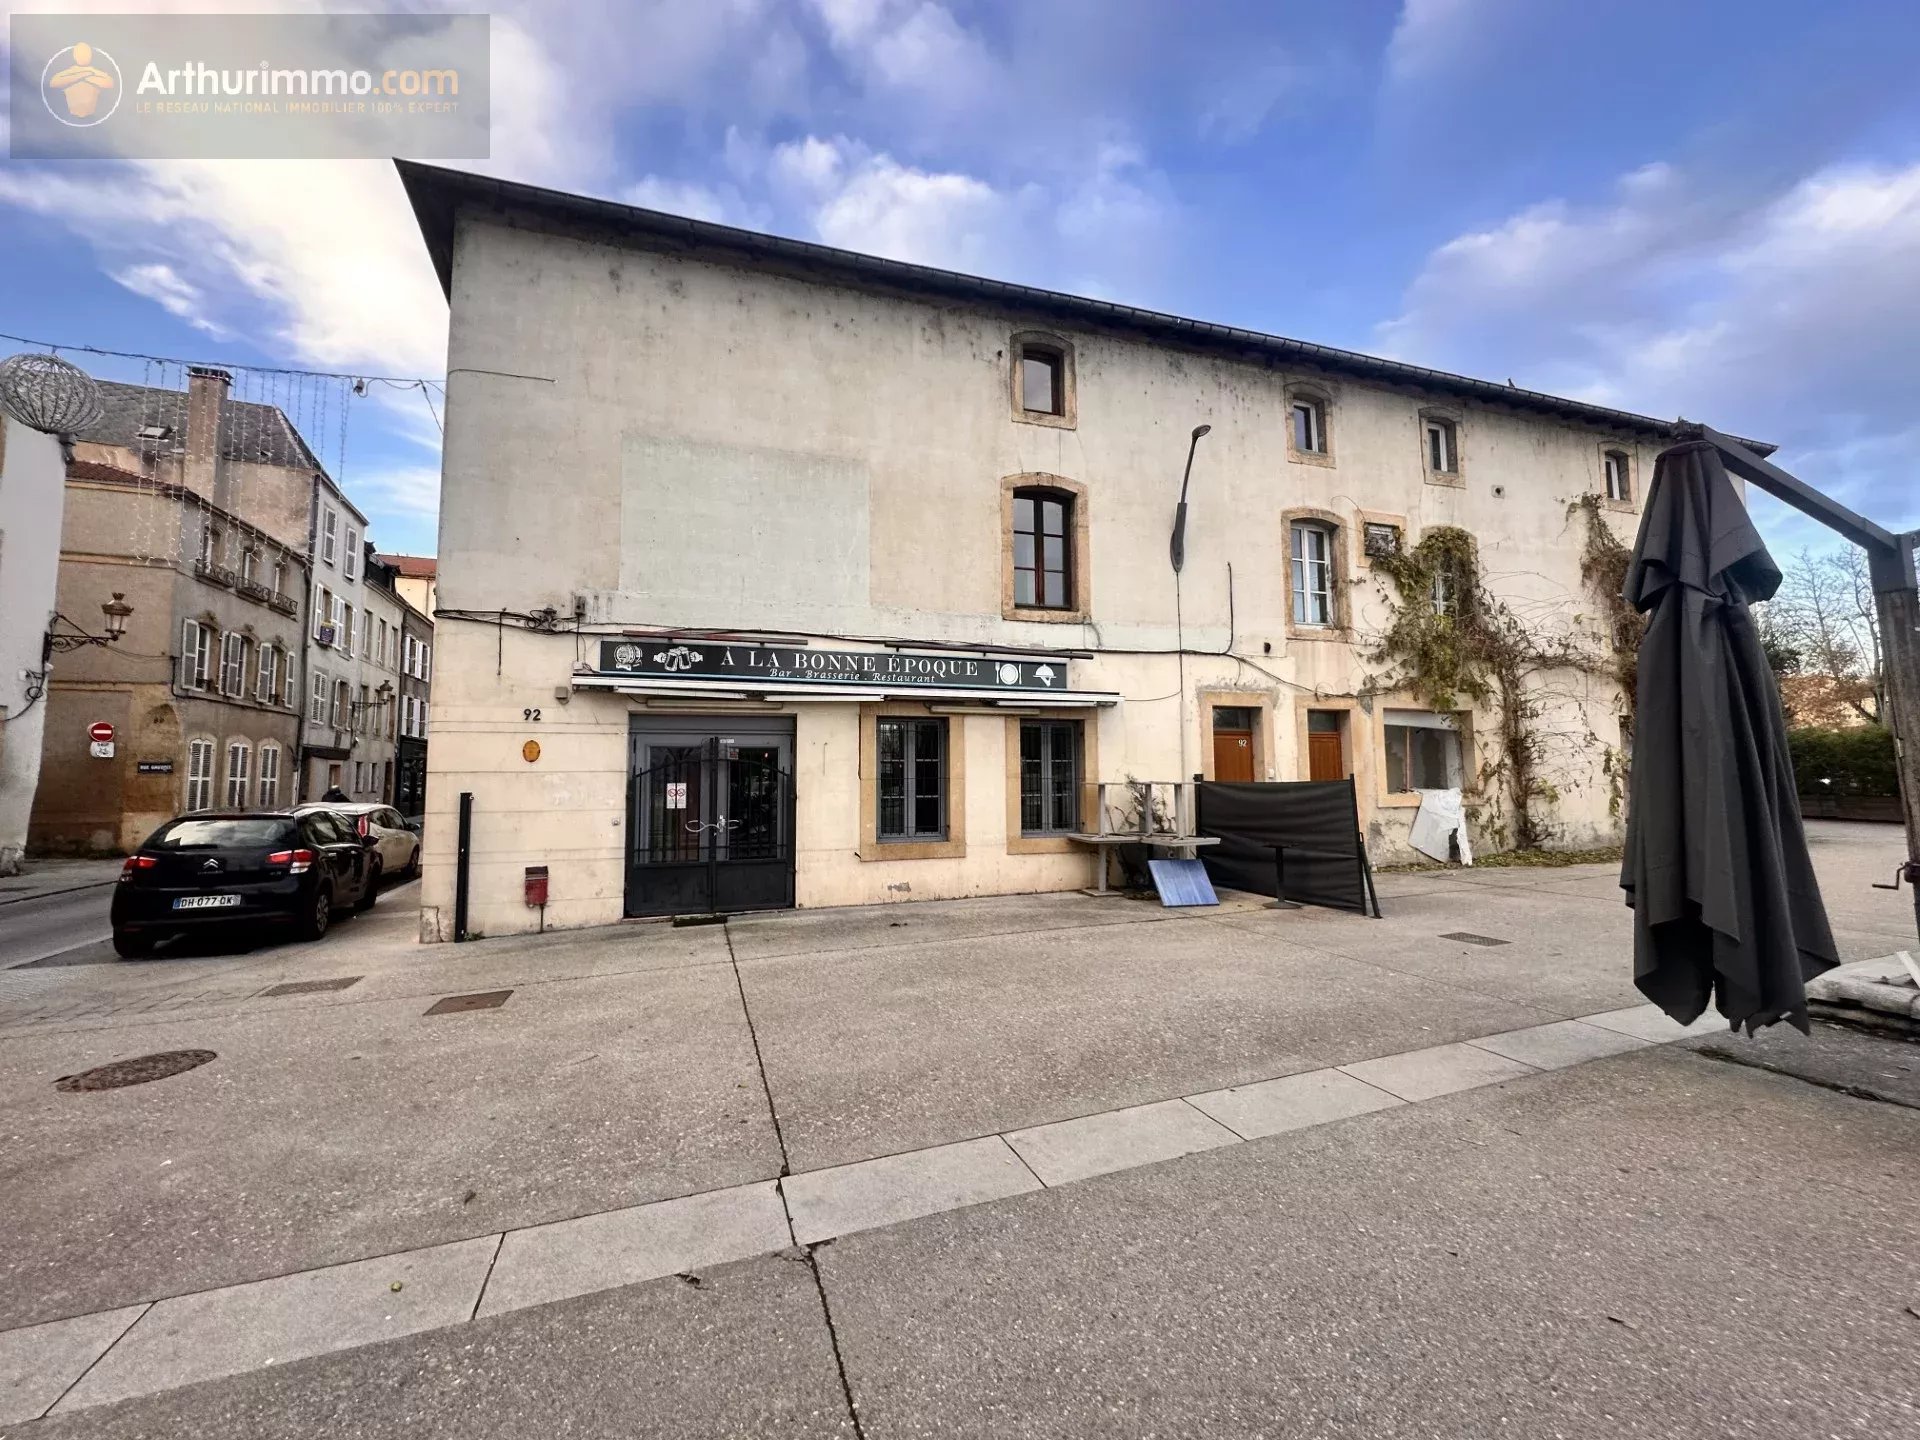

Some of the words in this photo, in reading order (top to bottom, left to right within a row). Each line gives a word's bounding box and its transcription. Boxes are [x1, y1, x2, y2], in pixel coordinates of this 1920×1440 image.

[748, 650, 781, 667] LA
[793, 653, 876, 672] BONNE
[887, 654, 978, 678] ÉPOQUE
[769, 668, 792, 678] Bar
[805, 669, 860, 680] Brasserie
[872, 672, 936, 683] Restaurant
[523, 708, 541, 721] 92
